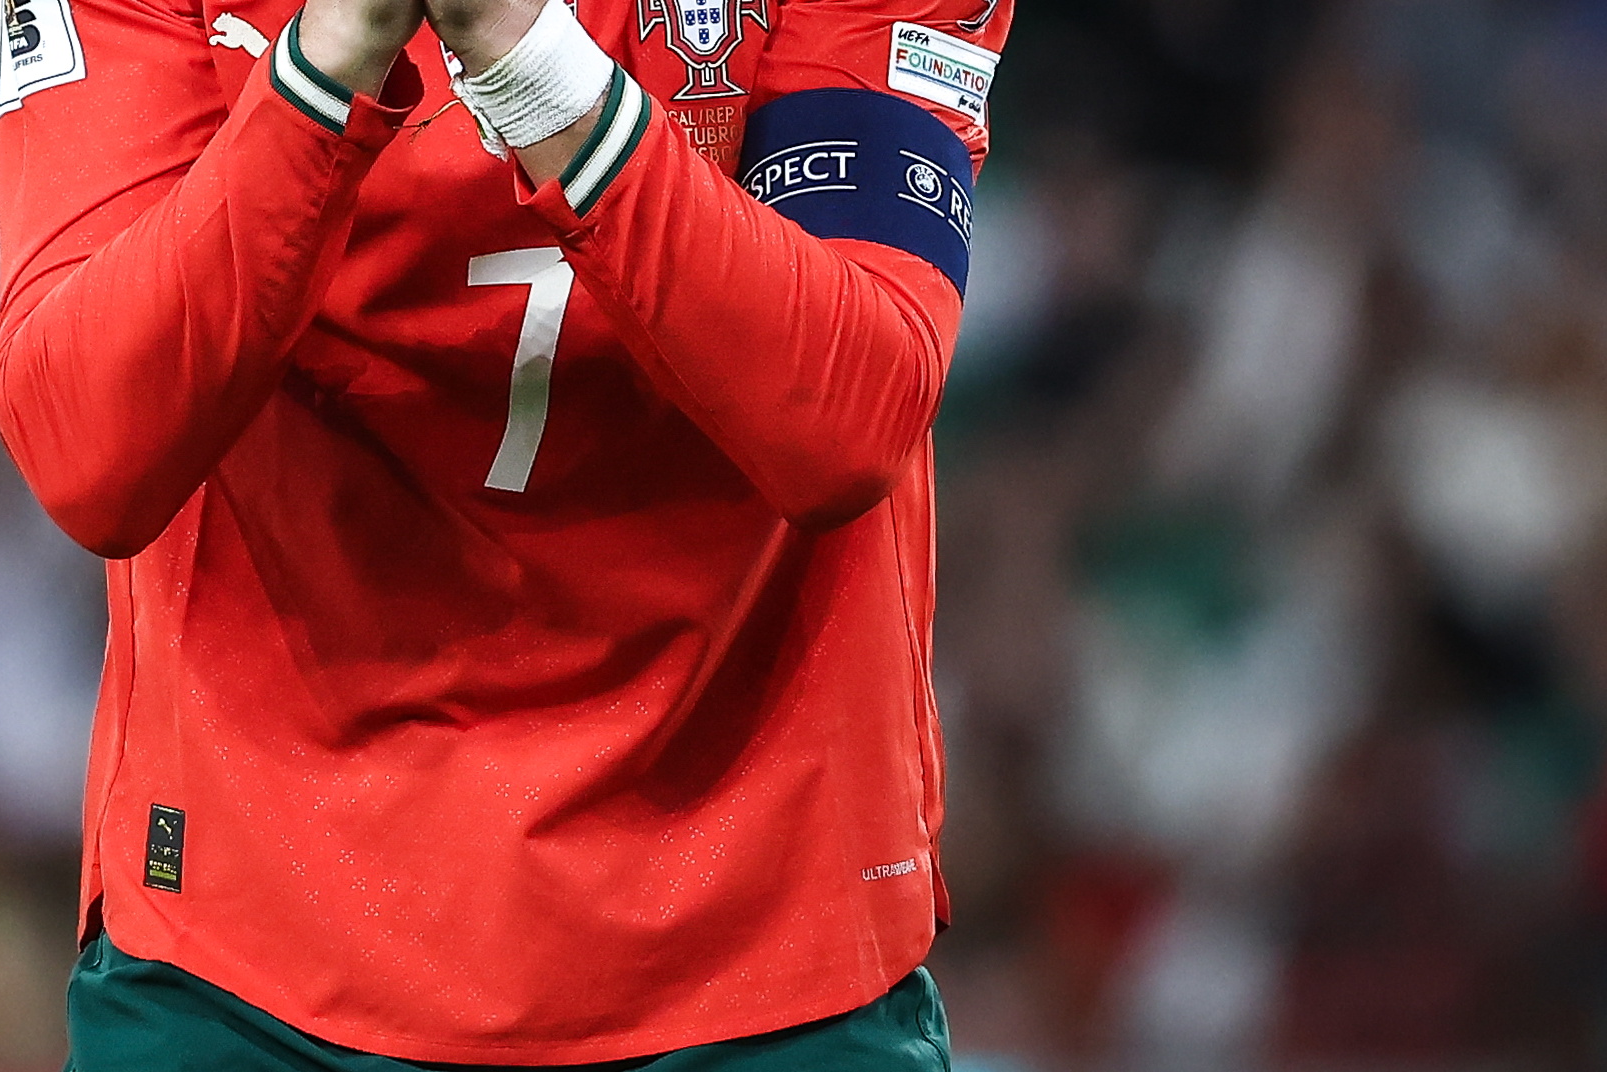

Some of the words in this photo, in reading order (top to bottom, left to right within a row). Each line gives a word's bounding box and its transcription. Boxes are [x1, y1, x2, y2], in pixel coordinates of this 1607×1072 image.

[898, 28, 930, 46] UEFA
[745, 152, 856, 201] SPECT
[467, 246, 575, 493] 7
